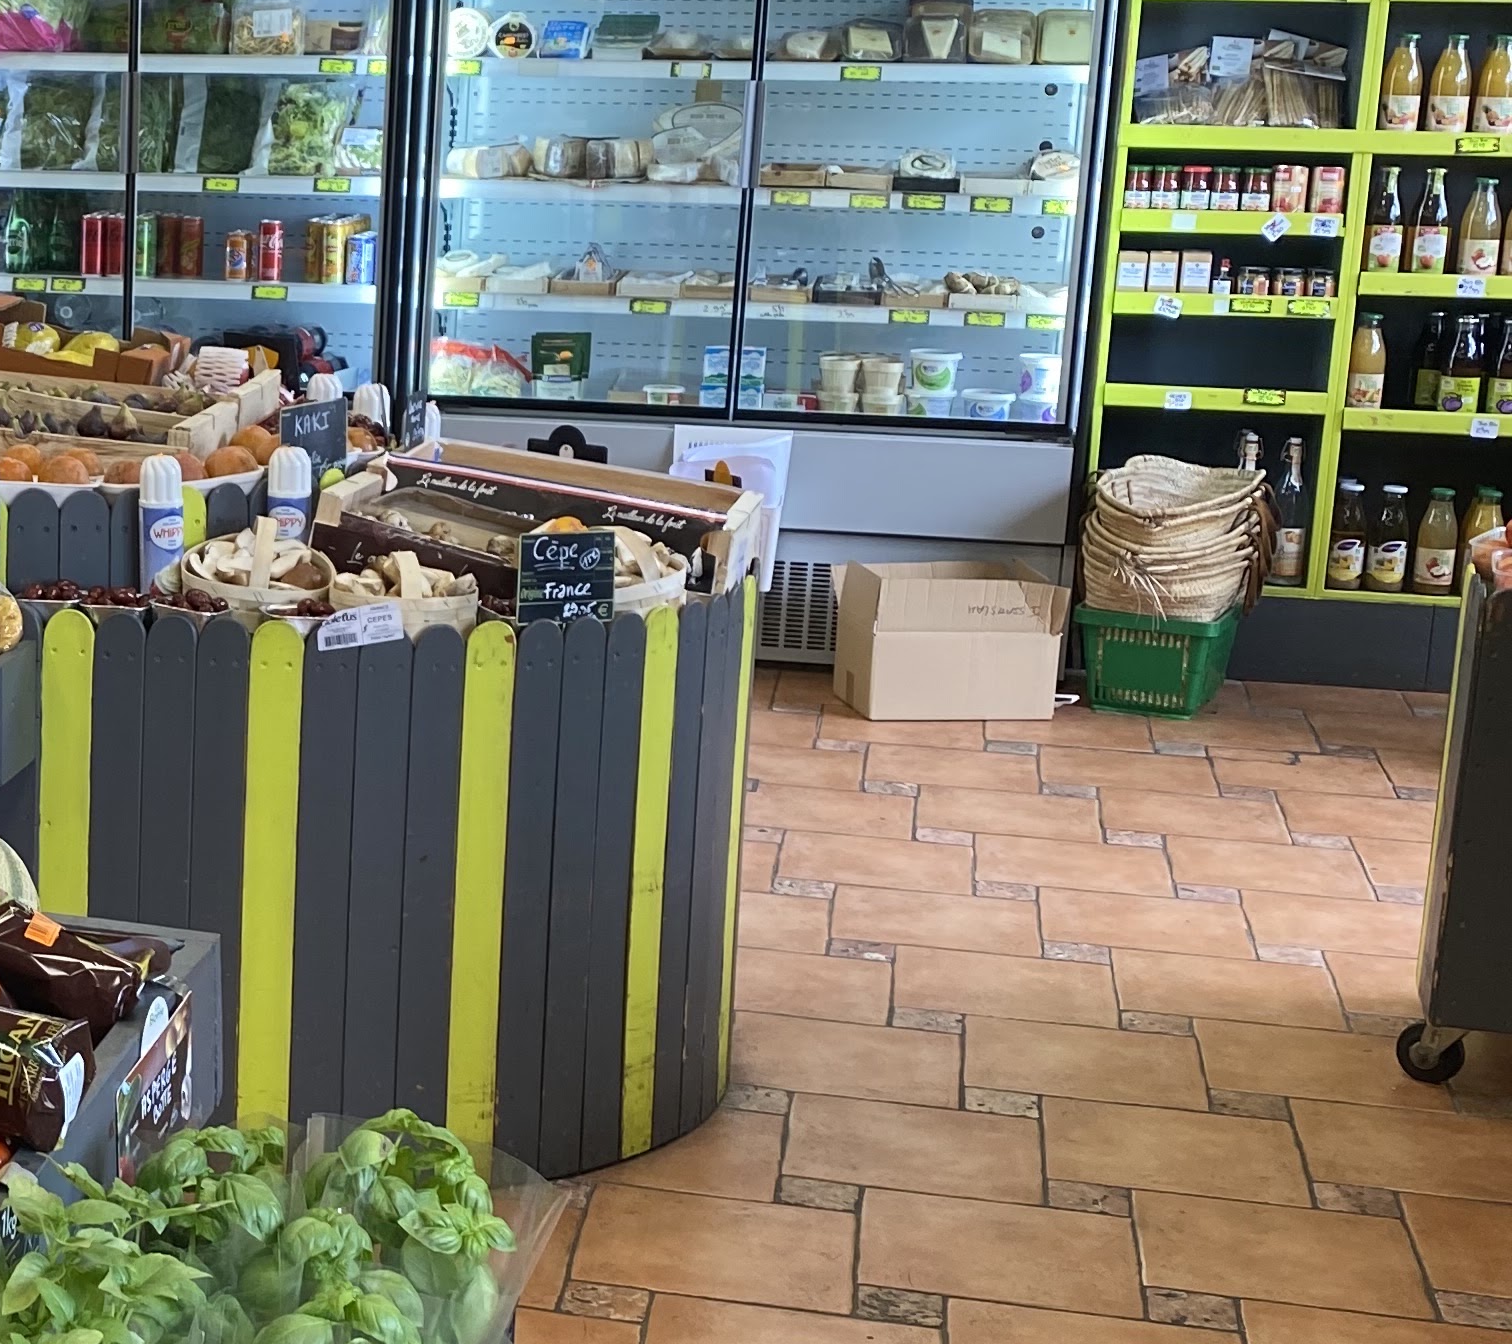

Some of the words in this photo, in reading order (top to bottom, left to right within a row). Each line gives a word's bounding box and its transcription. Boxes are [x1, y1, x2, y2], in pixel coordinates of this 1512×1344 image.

[295, 410, 331, 438] KAKI
[277, 516, 303, 529] HIPPY
[153, 526, 183, 539] WHIPP
[544, 582, 592, 600] France
[0, 1206, 18, 1240] 1kg
